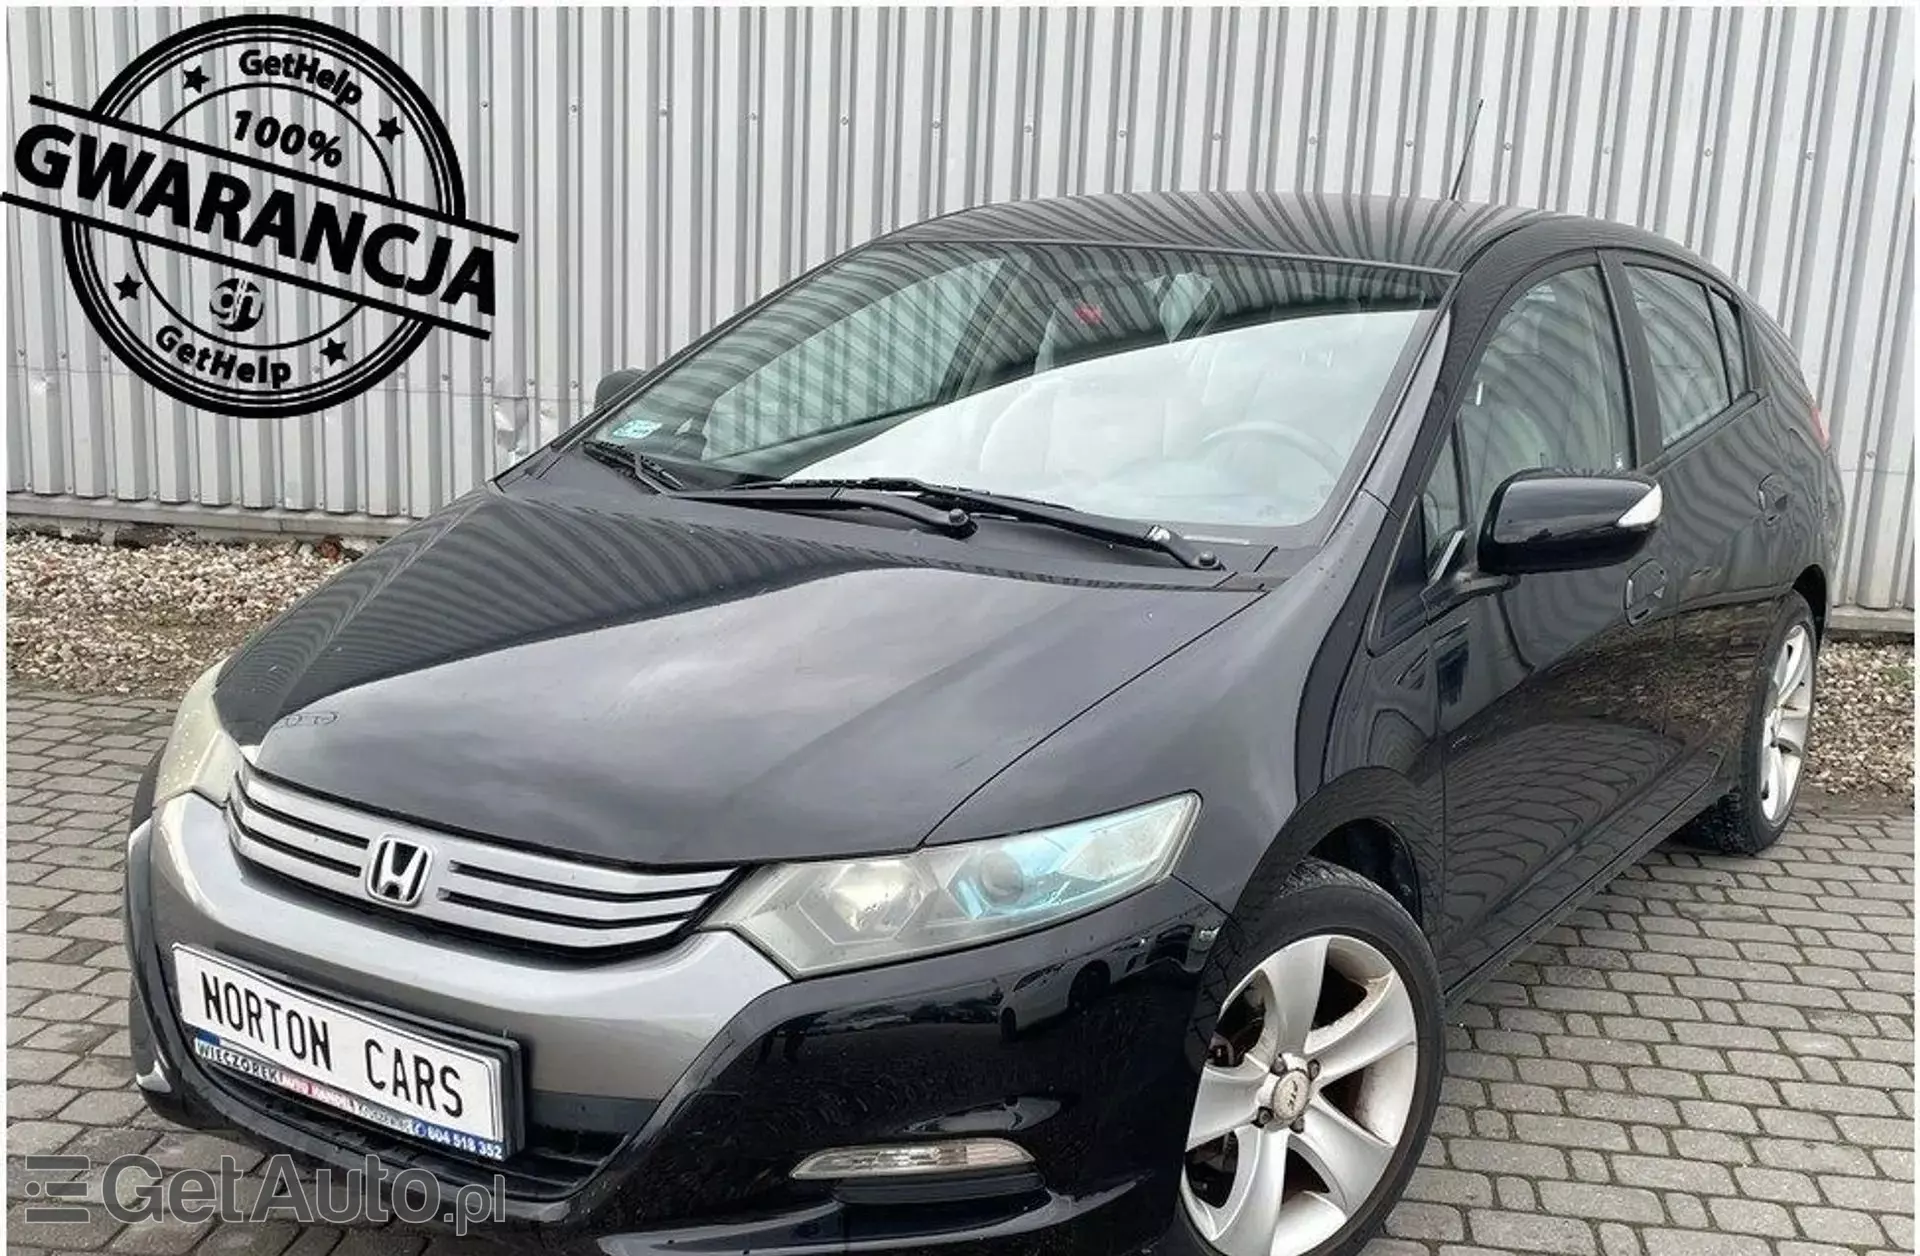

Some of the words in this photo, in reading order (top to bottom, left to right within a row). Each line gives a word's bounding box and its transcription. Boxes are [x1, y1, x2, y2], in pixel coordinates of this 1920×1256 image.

[201, 970, 332, 1072] NORTON
[365, 1038, 463, 1118] CARS
[477, 1141, 502, 1161] 352
